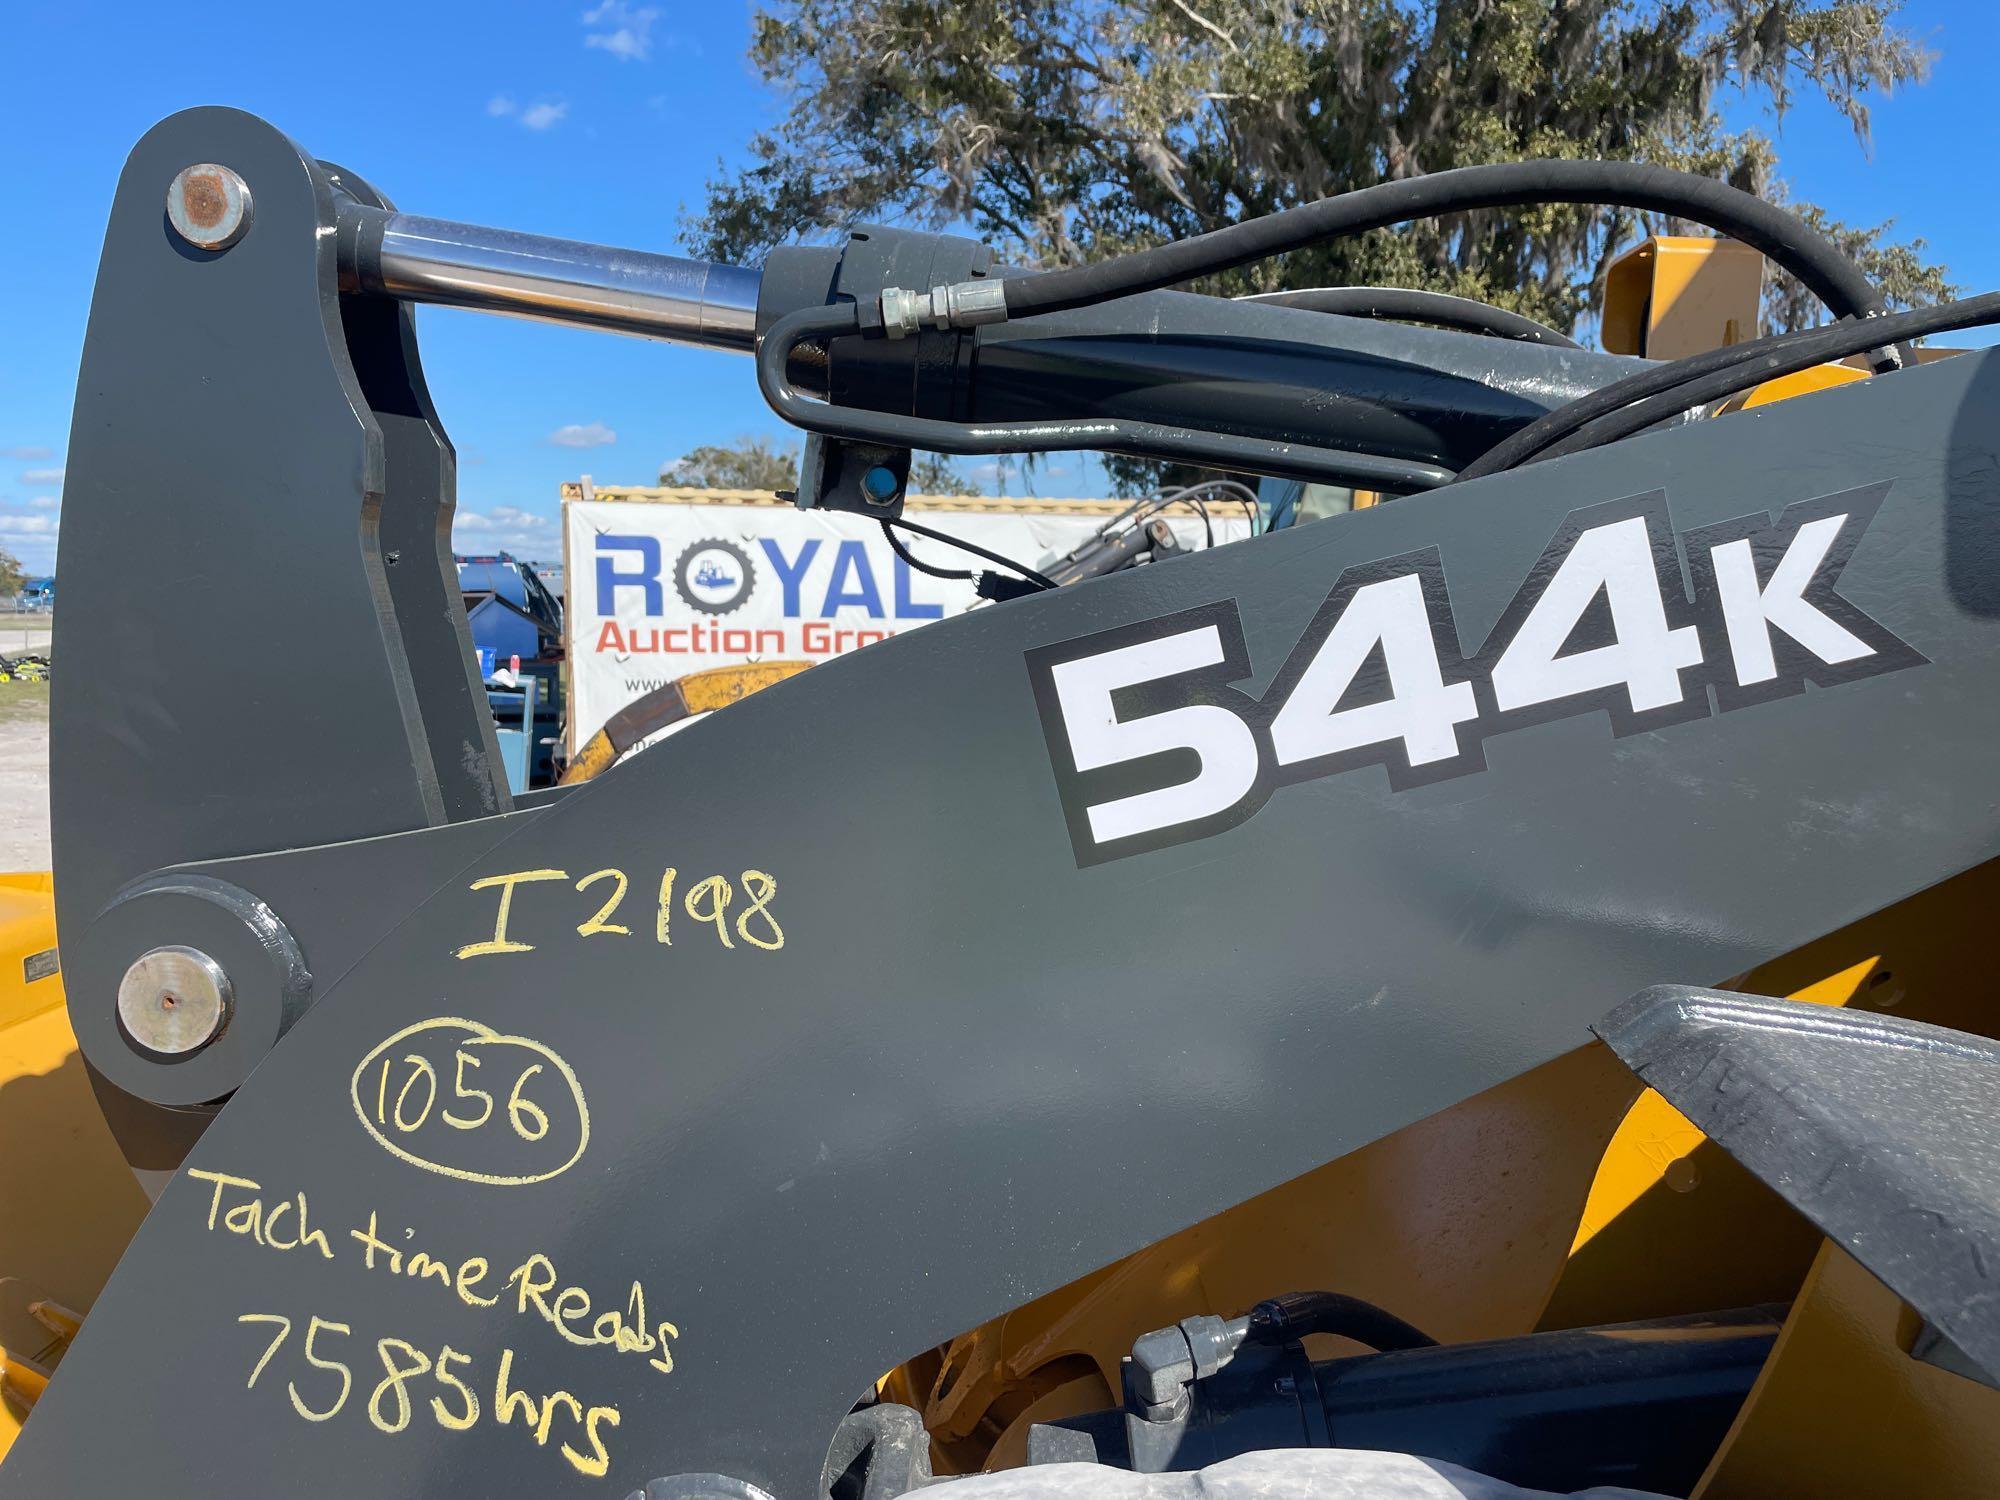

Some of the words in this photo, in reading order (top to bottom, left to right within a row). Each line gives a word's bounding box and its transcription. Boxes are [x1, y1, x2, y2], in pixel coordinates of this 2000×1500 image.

[595, 533, 944, 619] ROYAL
[595, 619, 785, 654] Auction
[801, 622, 896, 654] Gro
[1051, 514, 1878, 844] 544K
[378, 1049, 550, 1141] 1056
[187, 1167, 335, 1259] Tach
[351, 1210, 500, 1307] time
[506, 1253, 679, 1374] Reads
